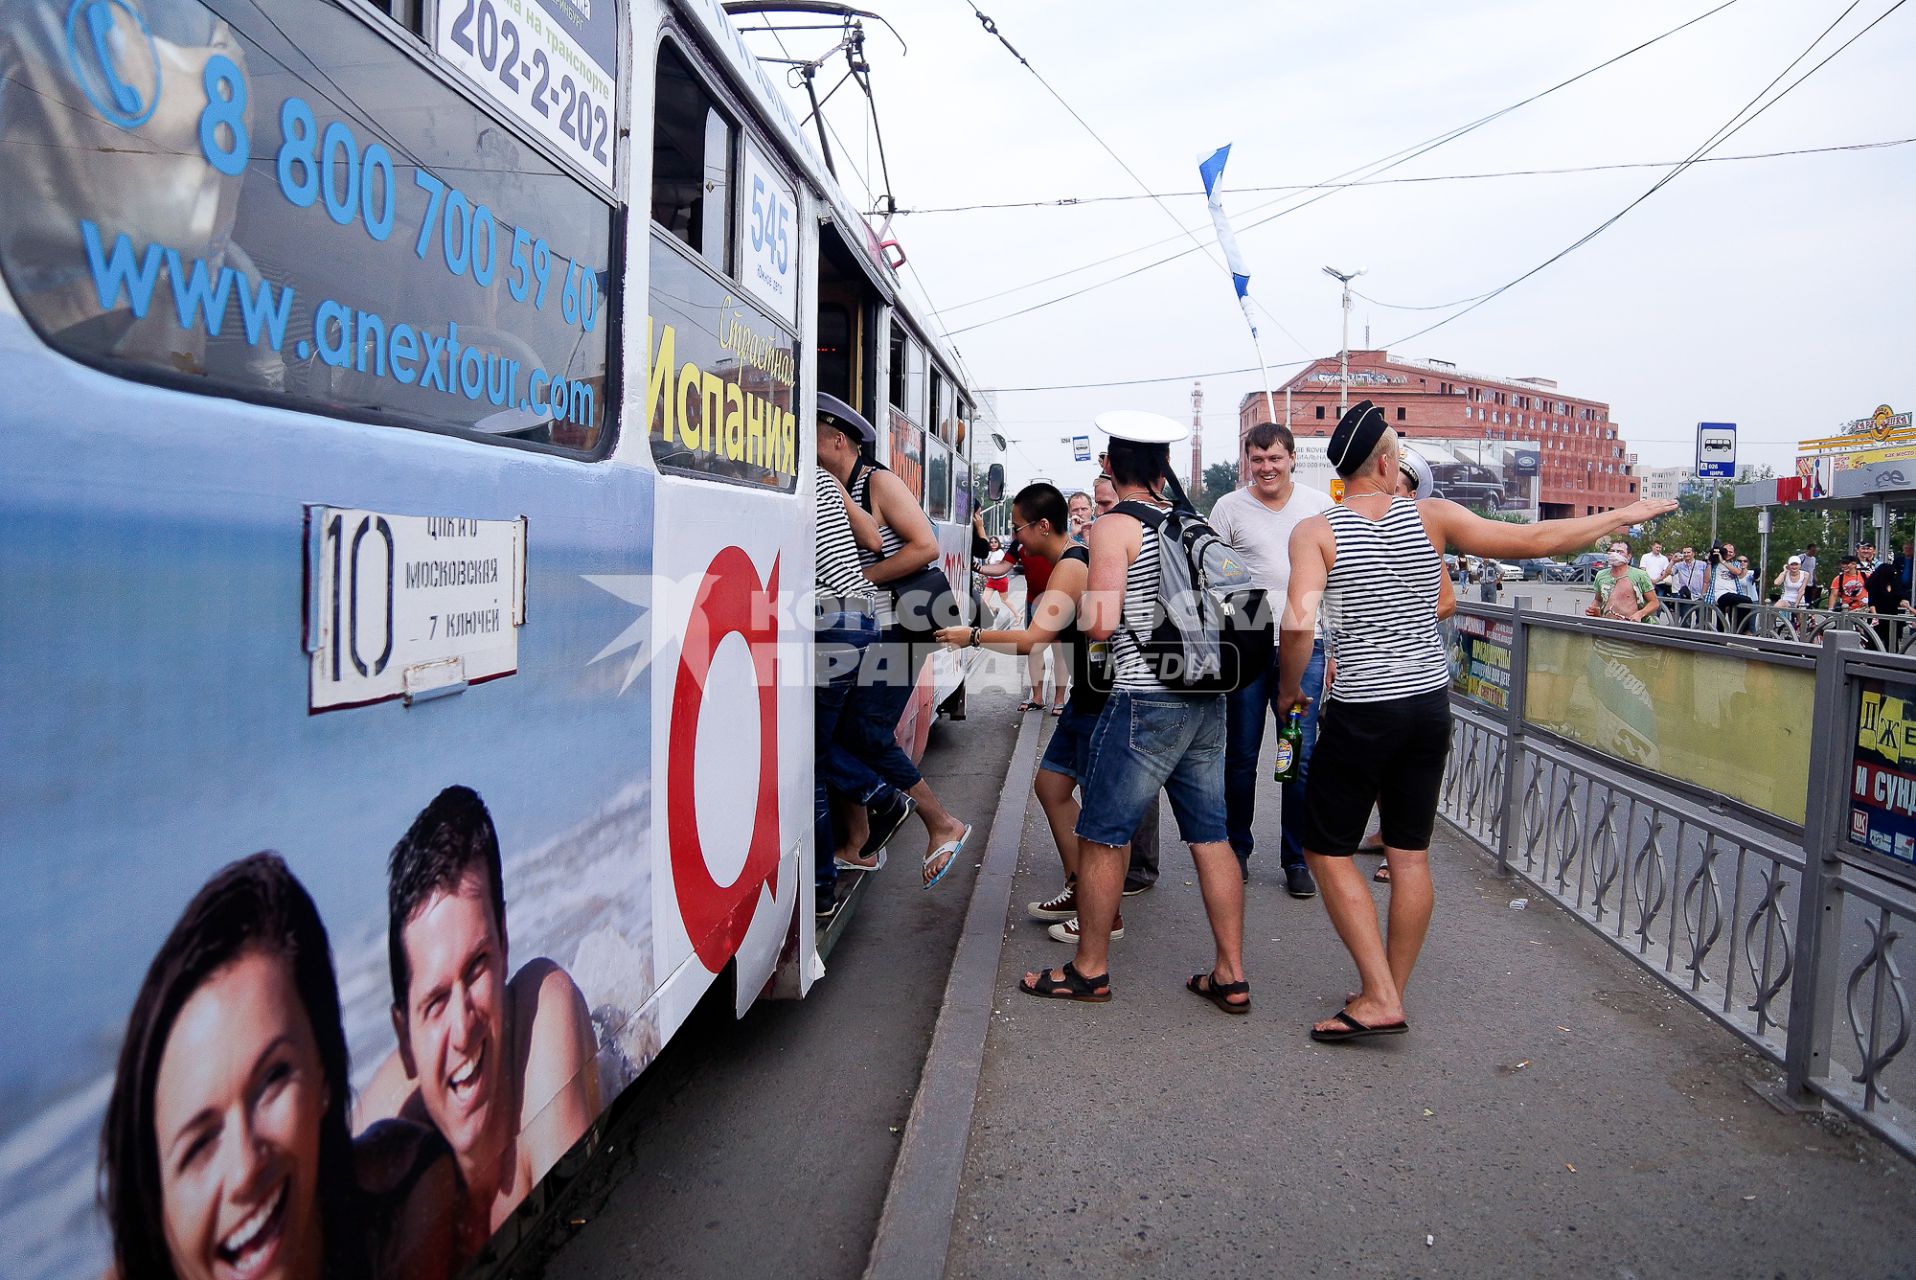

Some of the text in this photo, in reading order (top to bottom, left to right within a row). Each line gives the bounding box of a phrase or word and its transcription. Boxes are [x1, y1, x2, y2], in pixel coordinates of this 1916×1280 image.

[451, 0, 608, 168] 202-2-202
[526, 7, 541, 36] на
[546, 26, 609, 100] транспорте
[200, 54, 598, 333] 8 800 700 59 60
[751, 173, 789, 275] 545
[80, 219, 595, 428] www.anextour.com
[719, 294, 796, 388] Страстная
[646, 314, 797, 477] Испания
[327, 514, 394, 682] 10
[406, 558, 498, 589] МОСКОВСКАЯ
[429, 600, 499, 640] 7 КЛЮЧЕЙ
